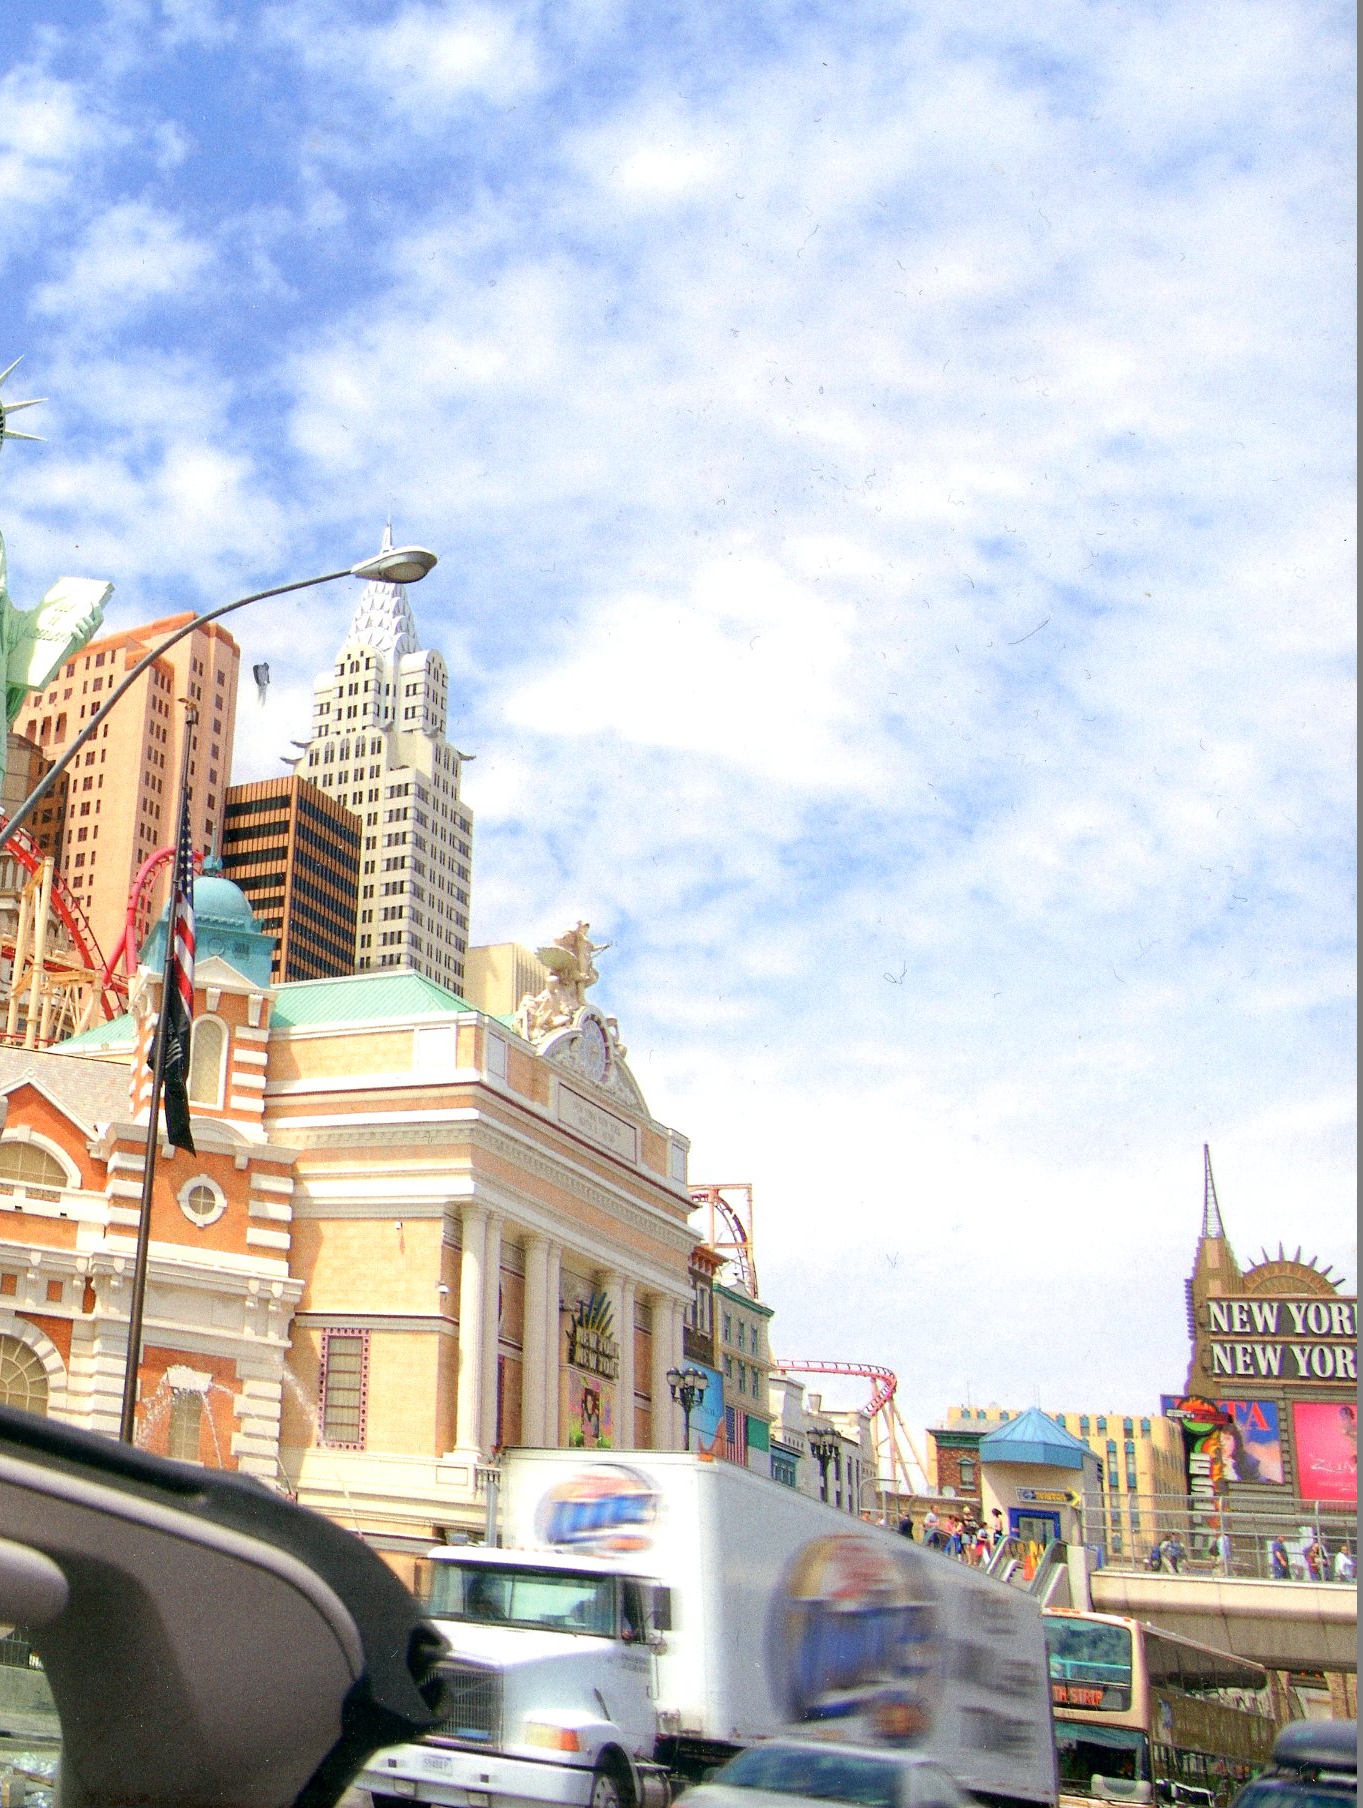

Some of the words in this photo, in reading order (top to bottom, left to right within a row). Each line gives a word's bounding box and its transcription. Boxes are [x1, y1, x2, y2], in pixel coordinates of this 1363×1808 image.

[1207, 1301, 1280, 1334] NEW
[1287, 1302, 1357, 1335] YOR
[1210, 1343, 1283, 1376] NEW
[1290, 1344, 1357, 1379] YOR
